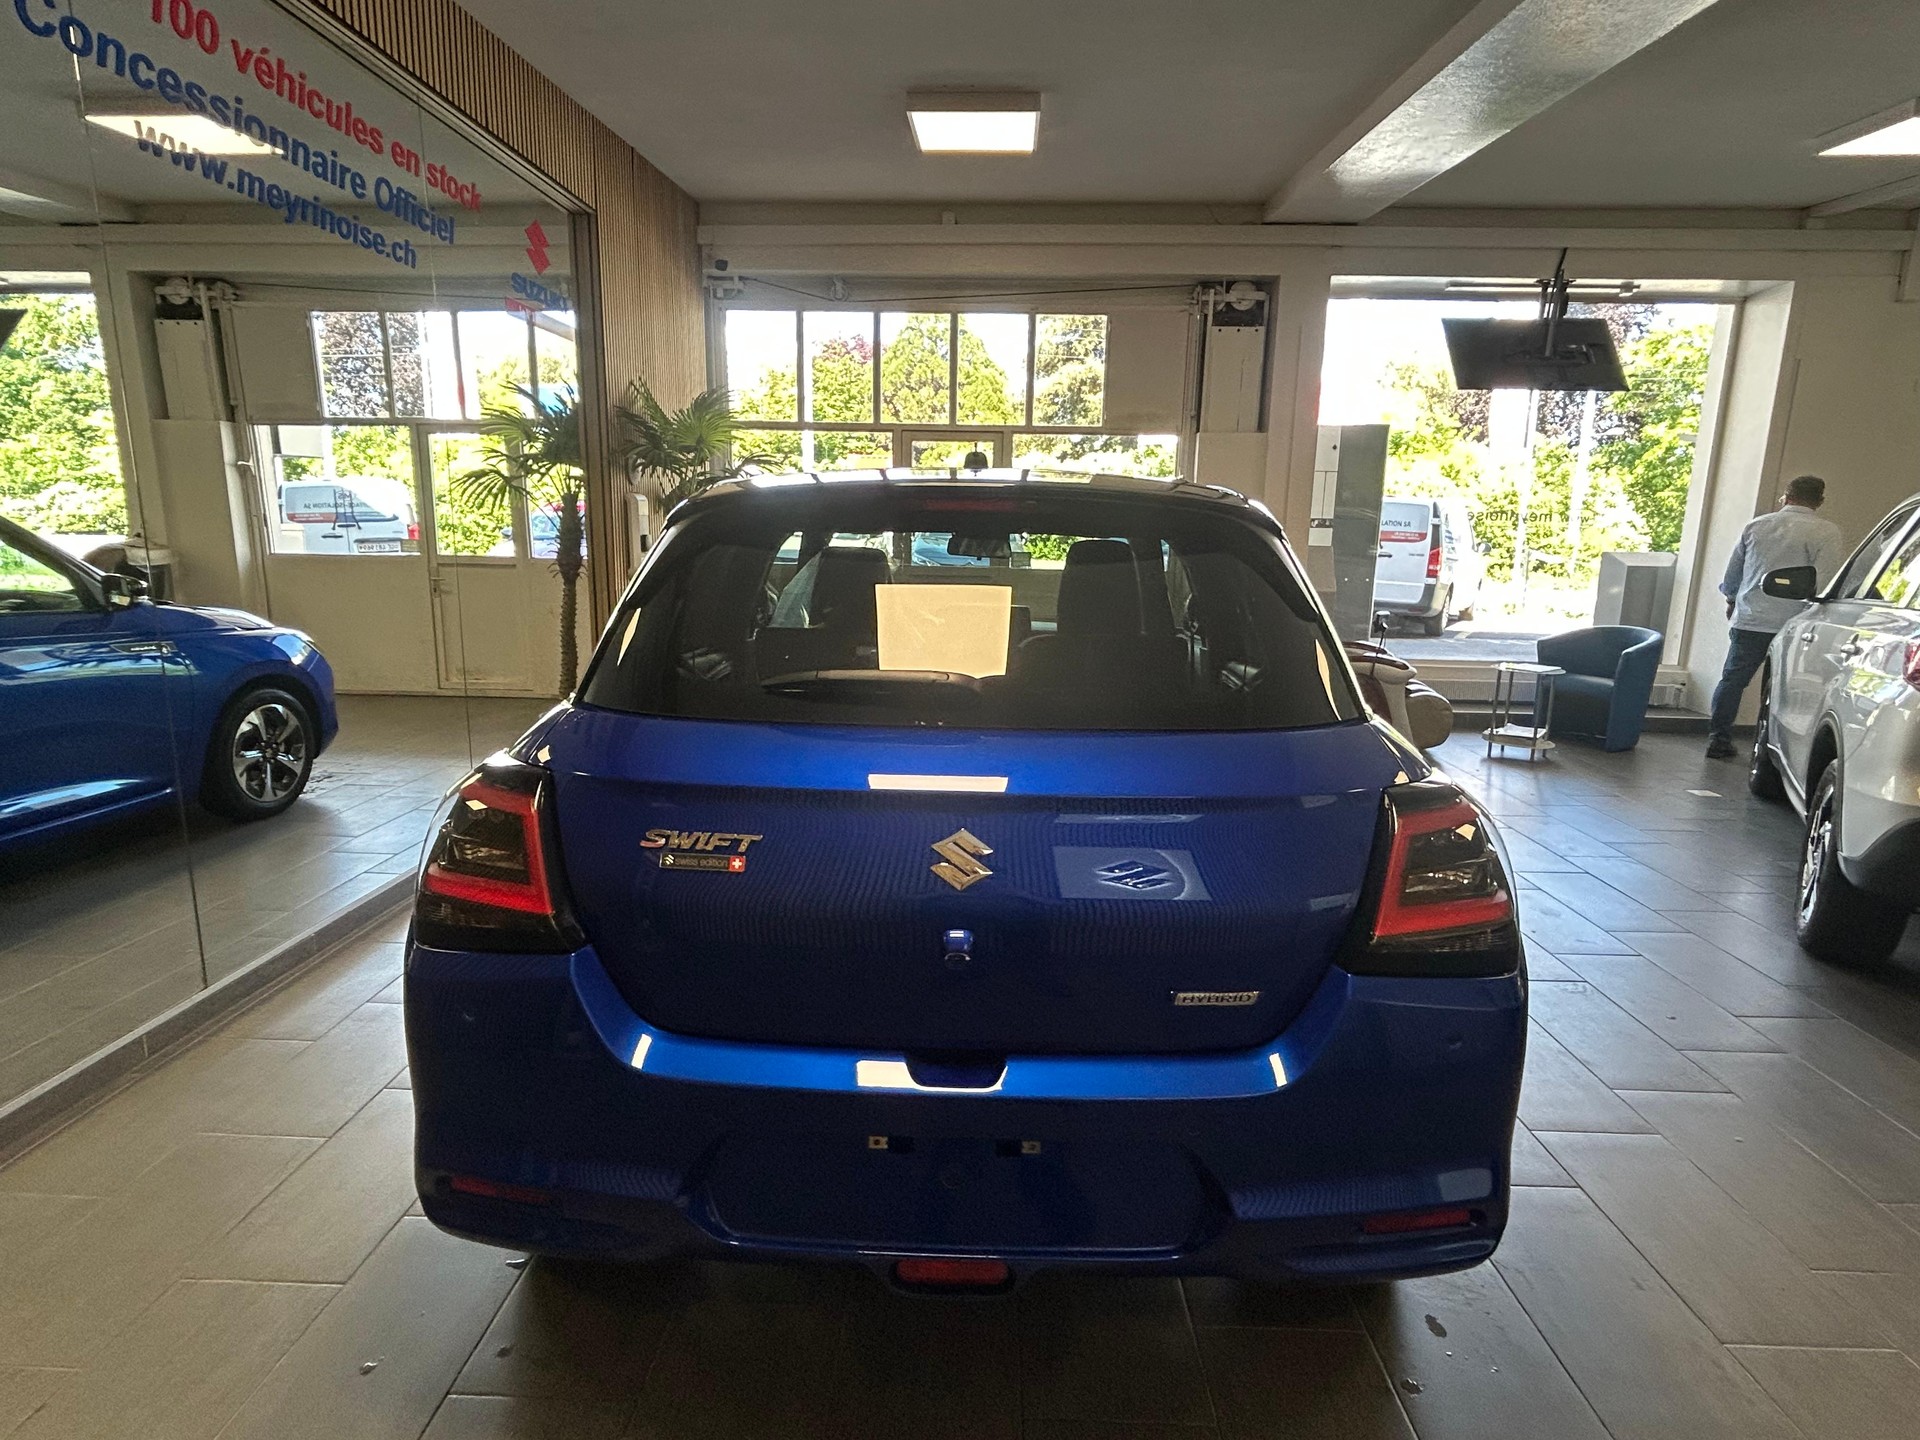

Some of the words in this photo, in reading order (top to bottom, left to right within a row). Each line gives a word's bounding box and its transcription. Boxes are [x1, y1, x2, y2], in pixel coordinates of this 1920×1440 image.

[14, 0, 367, 199] Concessionnaire
[374, 176, 455, 244] Officiel
[231, 39, 384, 155] véhicules
[391, 141, 421, 178] en
[426, 162, 482, 213] stock
[133, 119, 417, 269] www.meyrinoise.ch
[640, 829, 763, 853] SWIFT
[674, 858, 699, 866] swiss
[700, 858, 728, 867] edition
[1182, 994, 1252, 1004] HYBRID
